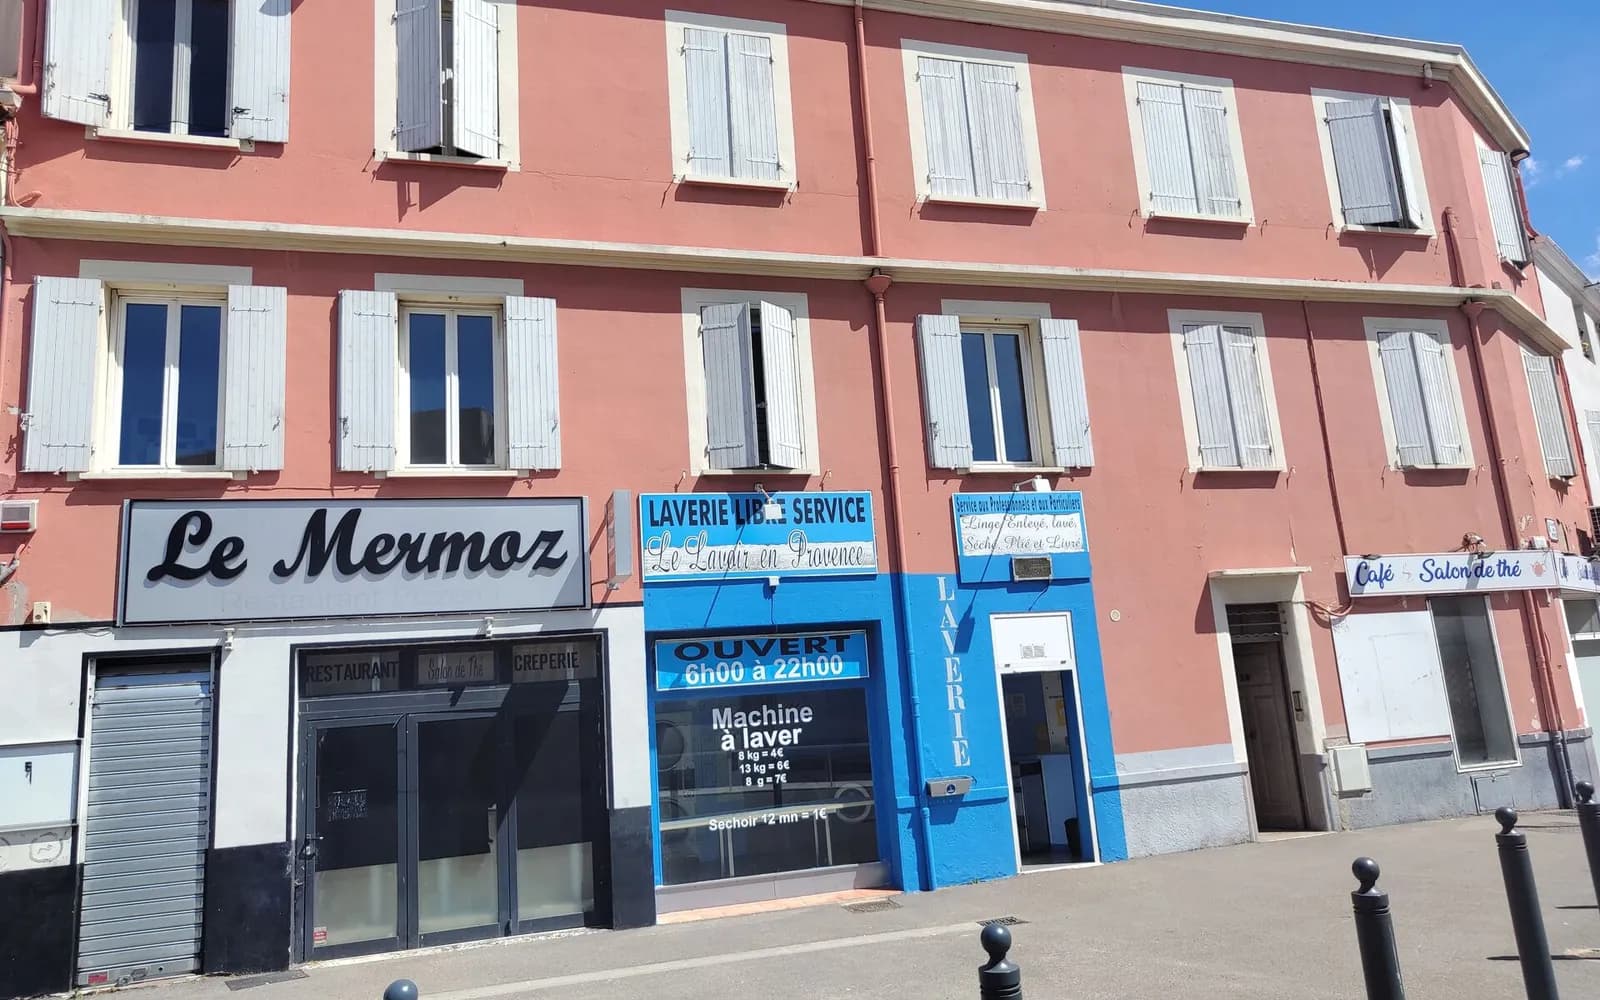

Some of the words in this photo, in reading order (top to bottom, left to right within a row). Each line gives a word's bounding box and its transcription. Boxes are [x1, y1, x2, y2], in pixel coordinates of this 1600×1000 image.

[650, 499, 729, 528] LAVERIE
[735, 497, 788, 526] LIBE
[792, 496, 866, 524] SERVICE
[956, 495, 978, 513] Service
[979, 500, 989, 512] aux
[1031, 496, 1038, 511] et
[1039, 499, 1049, 511] aux
[147, 509, 248, 582] Le
[273, 507, 568, 578] Mermoz
[646, 529, 680, 573] Le
[684, 528, 750, 573] Lavoir
[759, 545, 778, 569] en
[787, 528, 865, 568] Provence
[1356, 561, 1394, 589] Café
[1419, 558, 1472, 583] Salon
[1474, 560, 1495, 578] de
[1497, 558, 1522, 577] thé
[674, 635, 850, 661] OUVERT
[306, 660, 400, 683] RESTAURANT
[514, 651, 580, 672] CREPERIE
[685, 661, 745, 685] 6h00
[752, 659, 766, 681] à
[773, 654, 843, 680] 22h00
[937, 577, 971, 767] LAVERIE
[712, 703, 813, 730] Machine
[721, 728, 735, 751] à
[742, 727, 802, 749] laver
[738, 751, 745, 761] 8
[747, 750, 760, 761] kg
[761, 750, 769, 758] =
[770, 747, 784, 758] 4€
[739, 763, 751, 774] 13
[753, 762, 766, 774] kg
[777, 760, 790, 770] 6€
[774, 773, 787, 784] 7€
[709, 815, 758, 831] Sechoir
[761, 812, 776, 825] 12
[779, 811, 798, 824] mn
[812, 808, 828, 820] 1€
